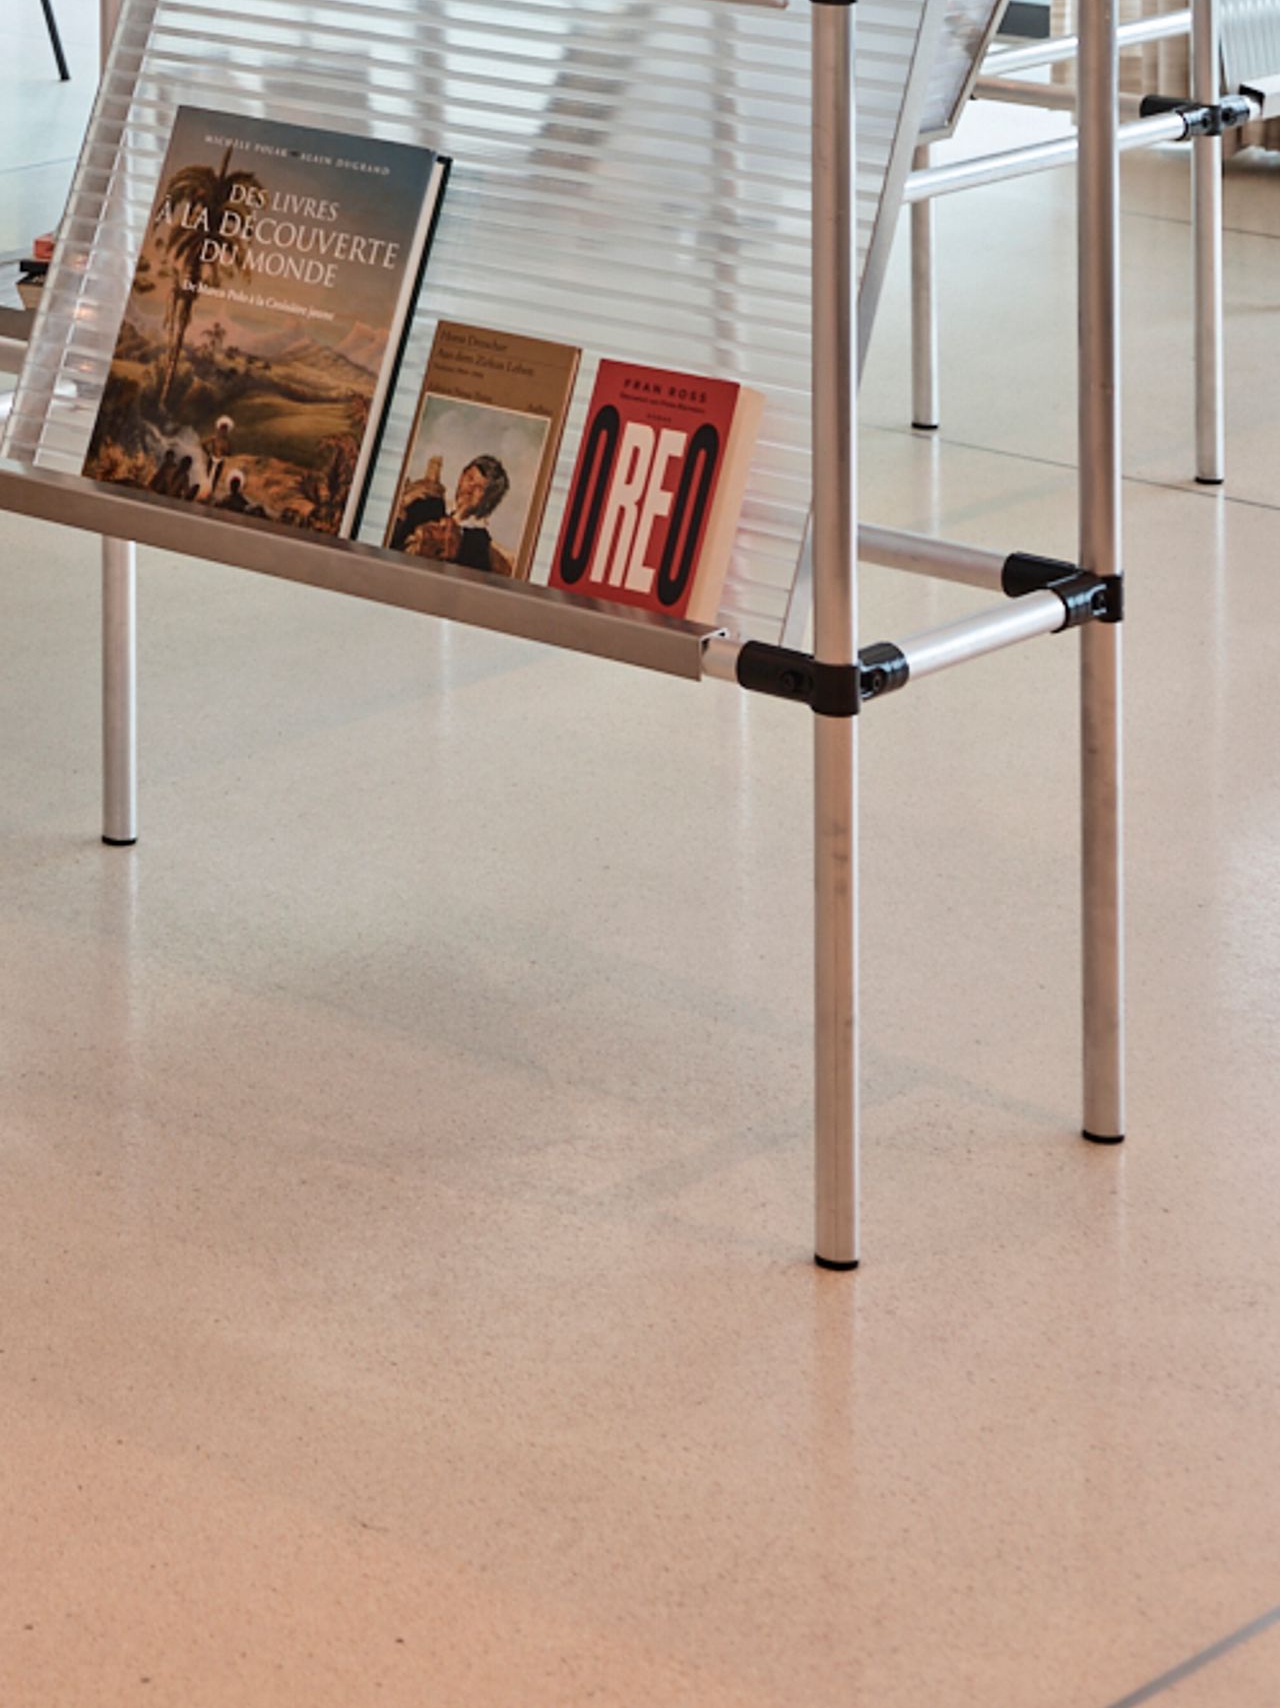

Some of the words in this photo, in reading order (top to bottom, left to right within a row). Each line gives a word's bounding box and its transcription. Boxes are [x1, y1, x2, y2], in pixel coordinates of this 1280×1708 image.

[228, 183, 269, 209] DES
[272, 190, 340, 222] LIVRES
[154, 193, 174, 226] À
[180, 201, 211, 233] LA
[218, 208, 401, 270] DÉCOUVERTE
[199, 239, 238, 267] DU
[242, 249, 340, 289] MONDE
[624, 378, 662, 394] FRAN
[668, 386, 708, 404] ROSS
[559, 404, 720, 607] OREO
